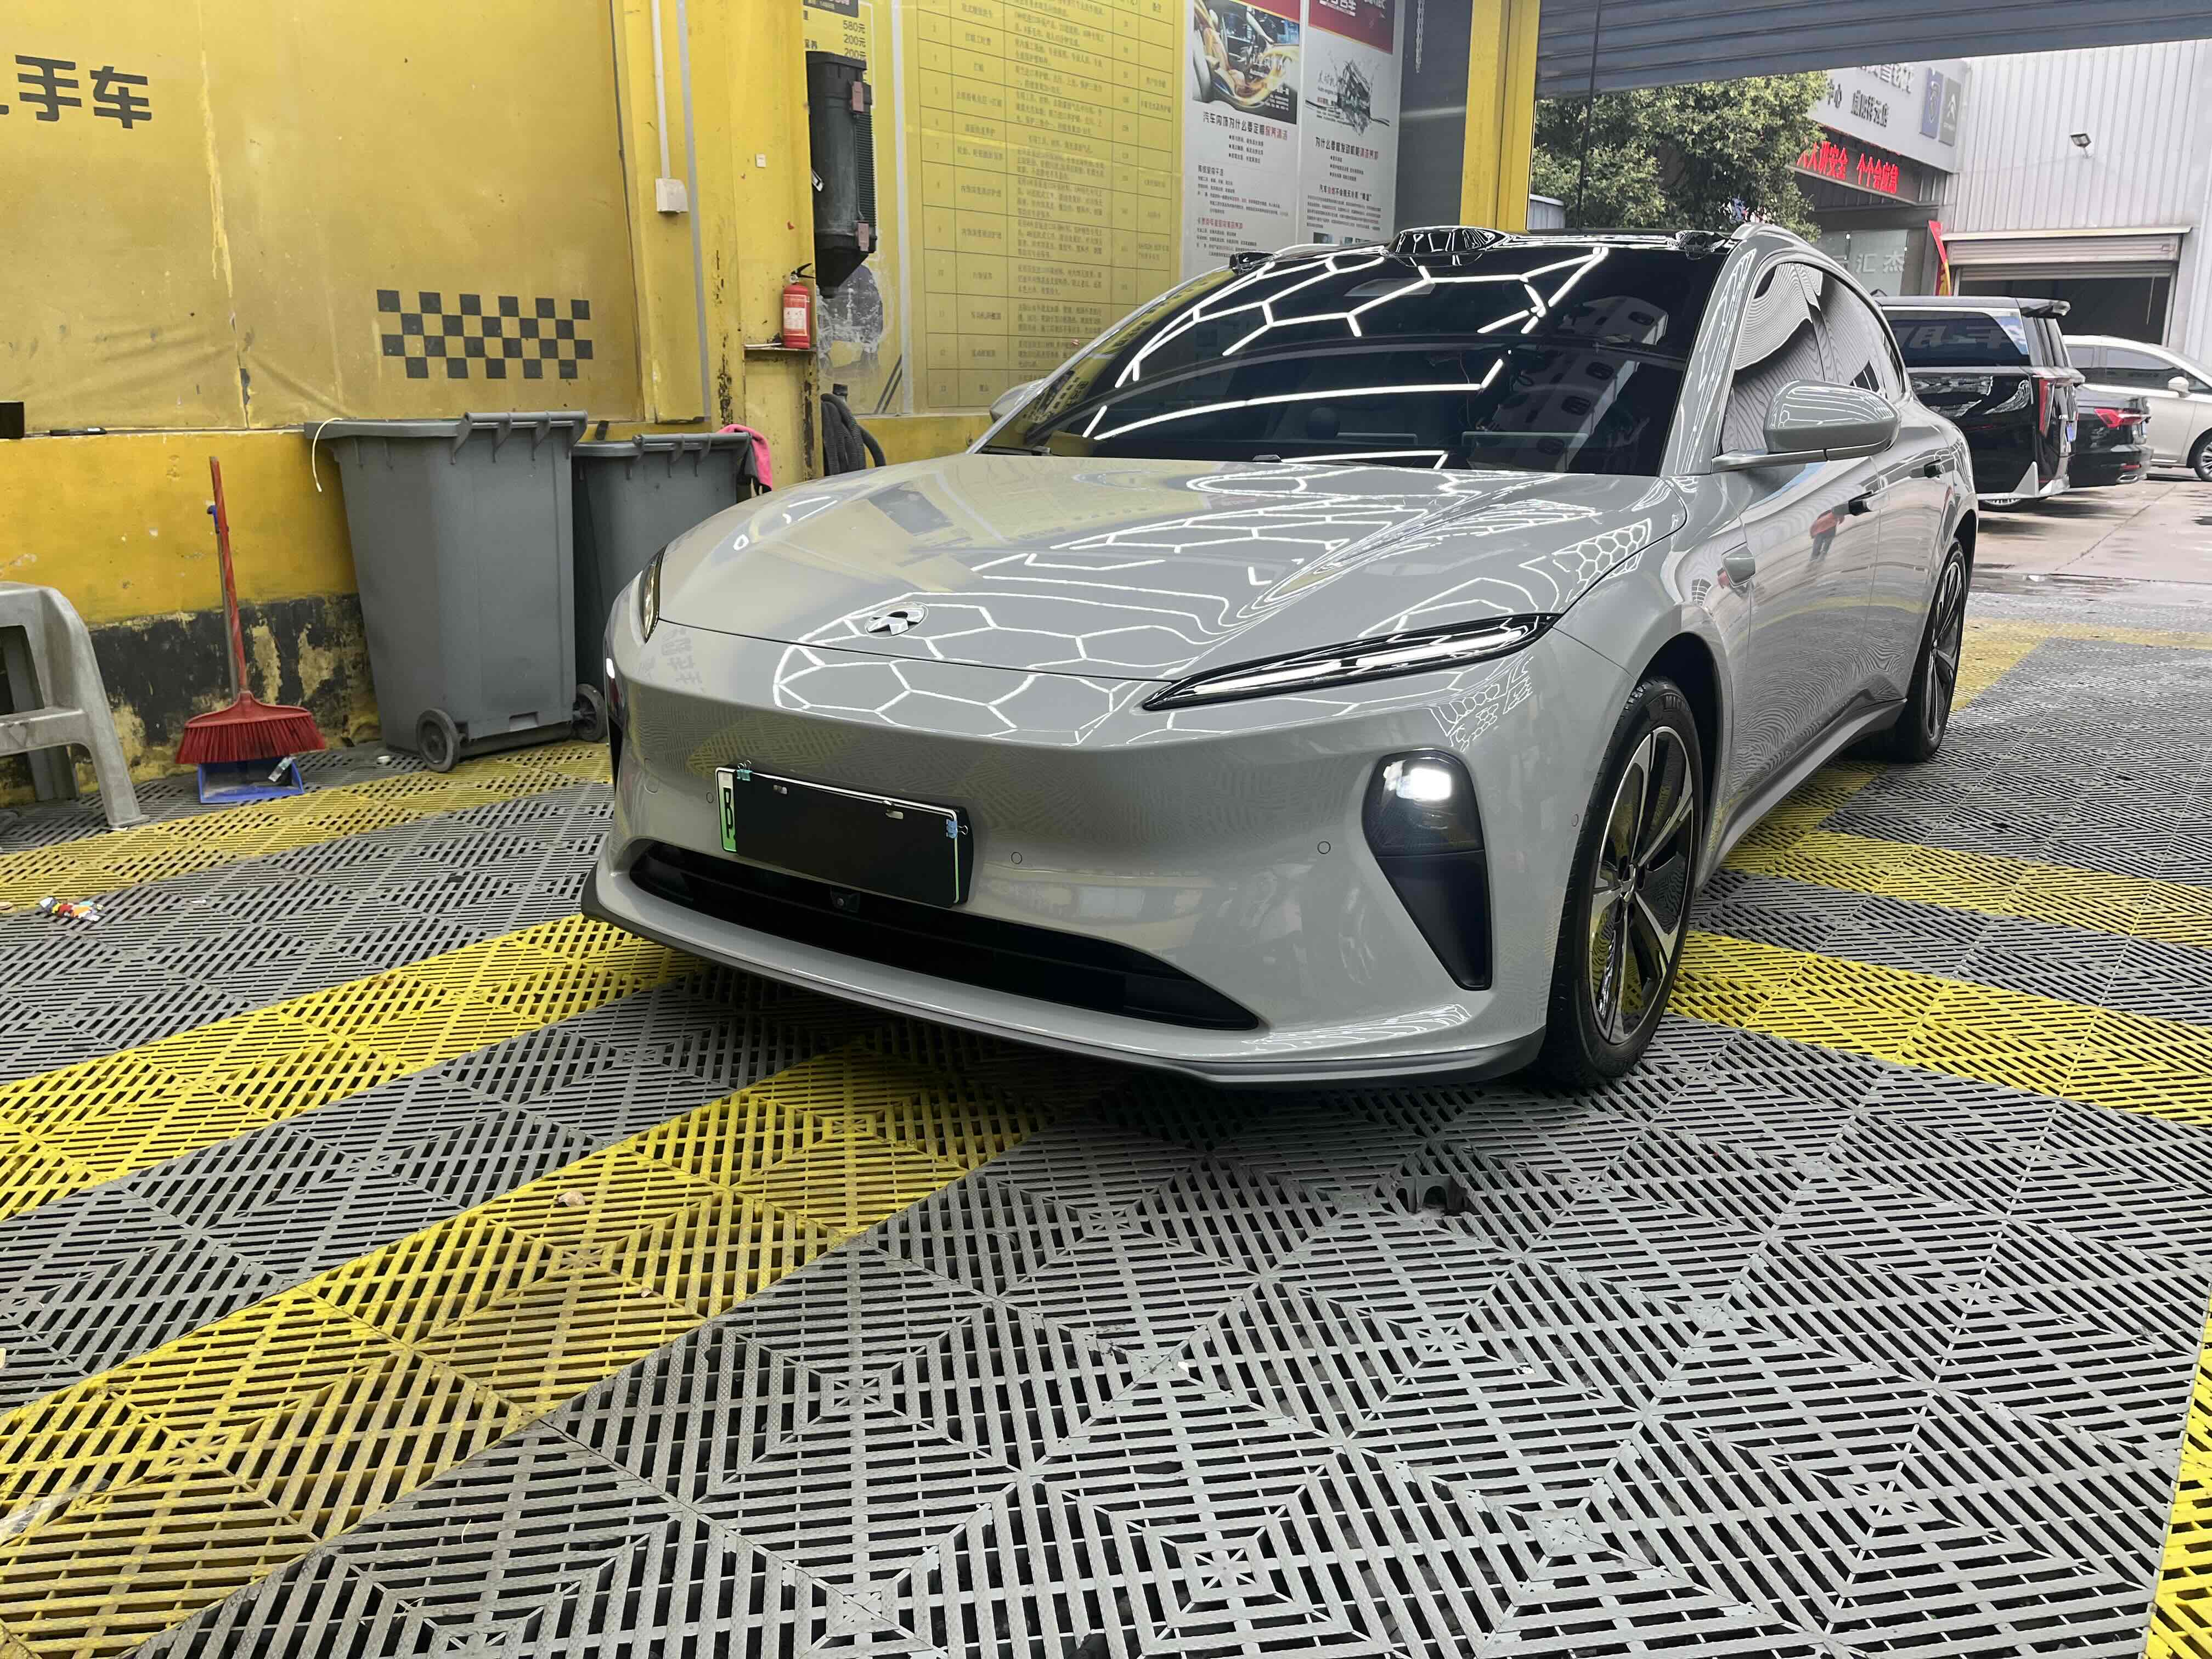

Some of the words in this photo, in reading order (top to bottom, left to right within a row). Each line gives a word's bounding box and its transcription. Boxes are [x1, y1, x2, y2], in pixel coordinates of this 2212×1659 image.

[843, 20, 865, 34] 580元
[843, 34, 866, 48] 200元
[0, 54, 152, 129] 手车
[1856, 153, 1900, 194] 个个会应急
